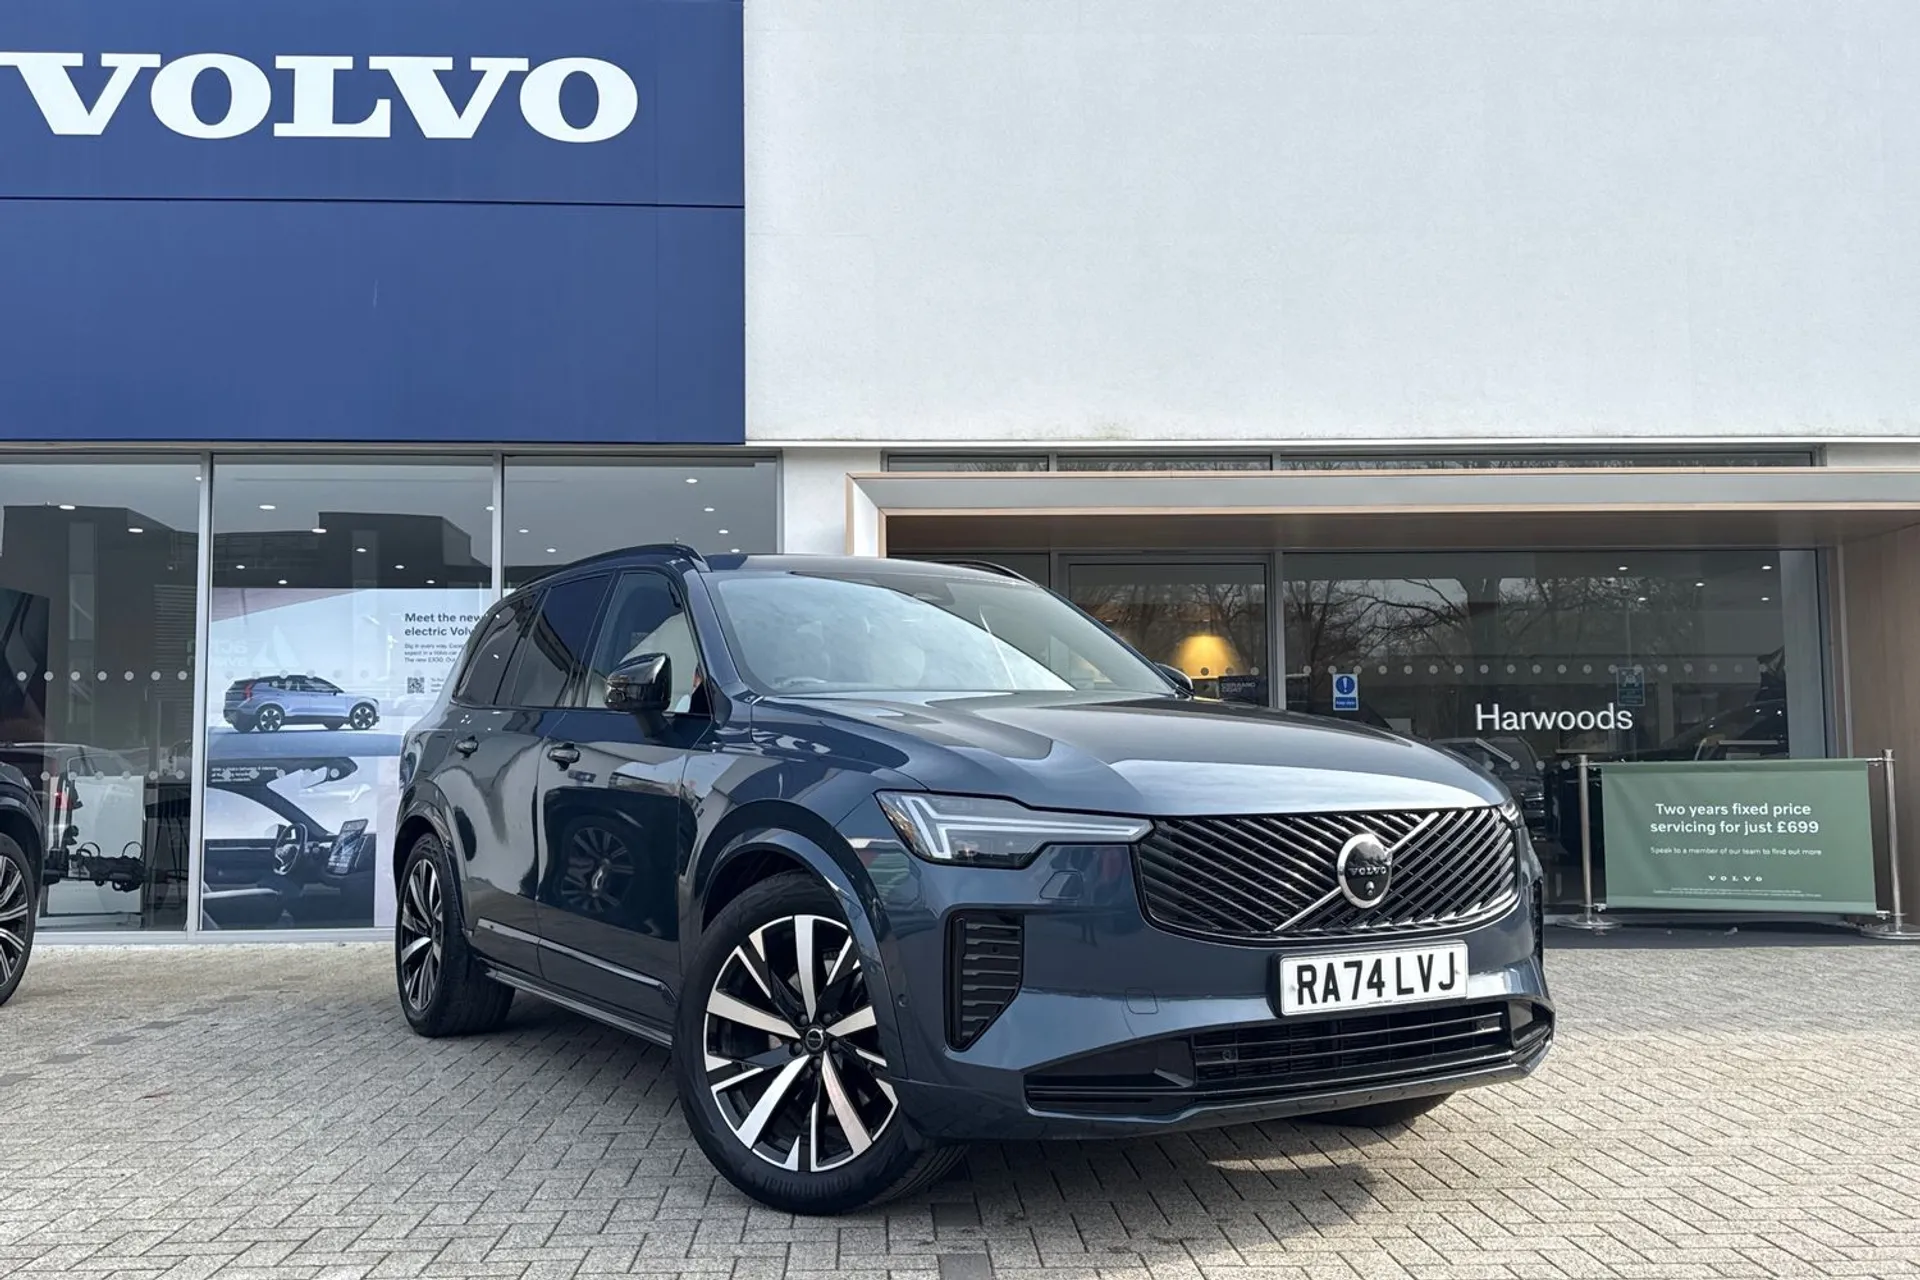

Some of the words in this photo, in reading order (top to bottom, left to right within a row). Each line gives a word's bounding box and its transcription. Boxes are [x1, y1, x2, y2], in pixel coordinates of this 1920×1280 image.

[0, 51, 638, 143] VOLVO
[404, 612, 434, 622] Meet
[437, 612, 456, 622] the
[404, 626, 447, 636] electric
[449, 626, 472, 636] Volv
[1475, 702, 1633, 731] Harwoods
[1655, 803, 1685, 815] Two
[1689, 805, 1729, 818] years
[1732, 803, 1768, 815] fixed
[1773, 803, 1812, 818] price
[1650, 821, 1716, 835] servicing
[1720, 821, 1741, 833] for
[1744, 821, 1772, 835] just
[1777, 820, 1819, 834] £699
[1650, 846, 1672, 855] Speak
[1720, 846, 1727, 855] of
[1742, 847, 1760, 855] team
[1771, 847, 1786, 855] find
[1788, 847, 1799, 855] out
[1348, 866, 1387, 876] VOLVO
[1297, 958, 1385, 1005] RA74
[1396, 952, 1455, 996] LVJ
